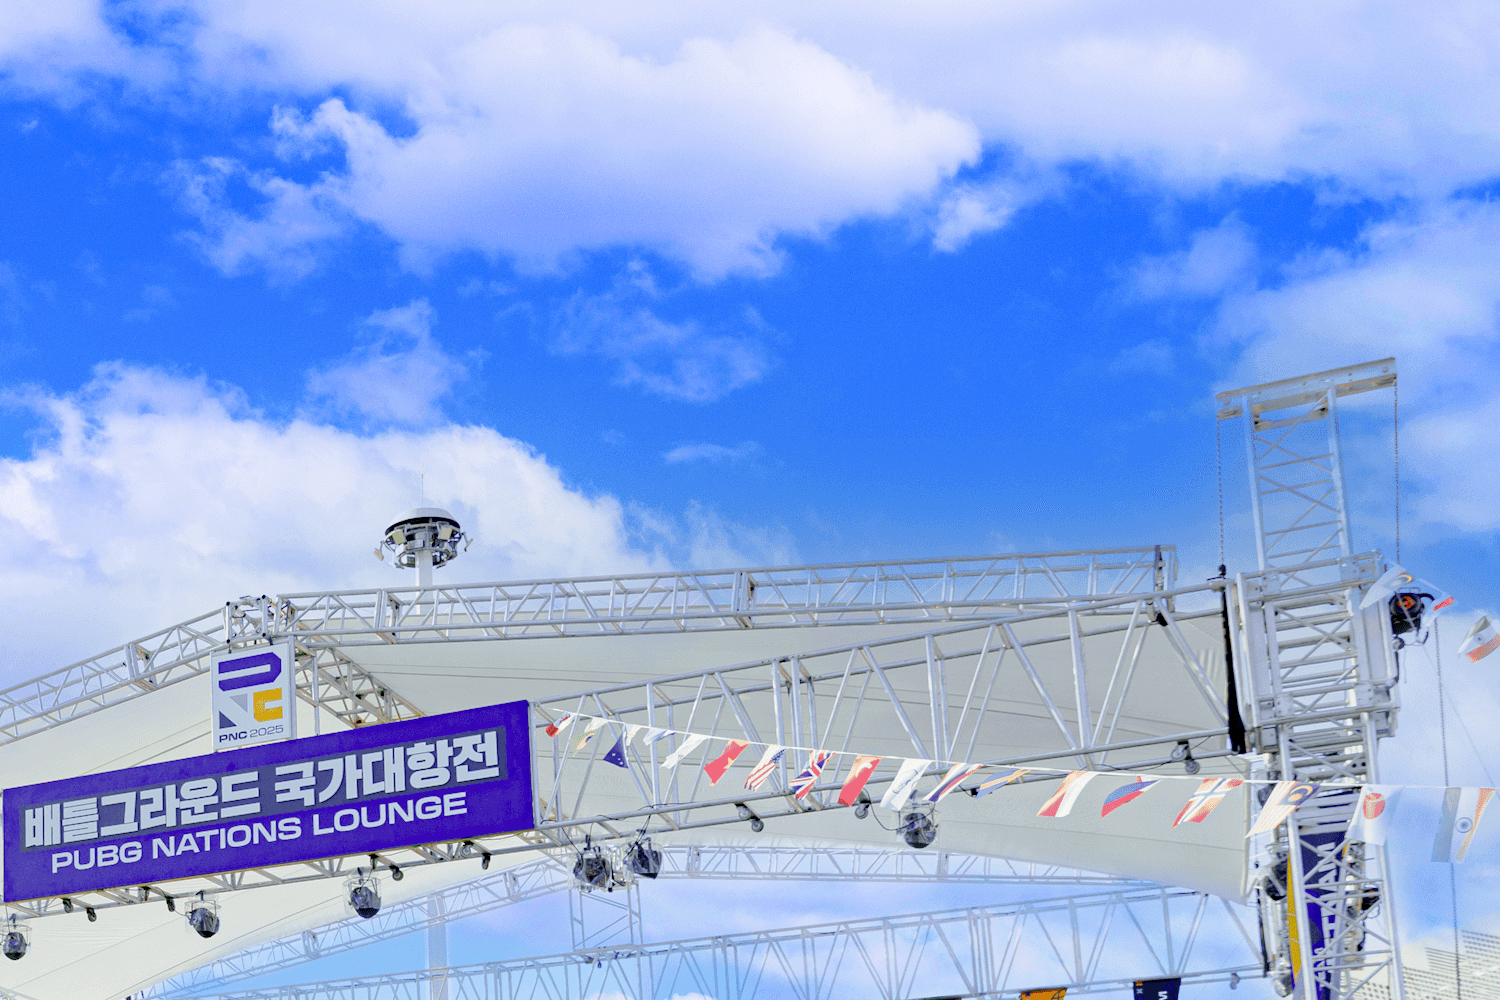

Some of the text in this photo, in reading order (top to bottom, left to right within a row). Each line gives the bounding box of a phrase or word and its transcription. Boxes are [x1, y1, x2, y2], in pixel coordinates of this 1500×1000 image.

[219, 724, 284, 743] PNC 2025
[24, 731, 501, 848] 배틀그라운드 국가대항전
[50, 791, 468, 874] PUBG NATIONS LOUNGE
